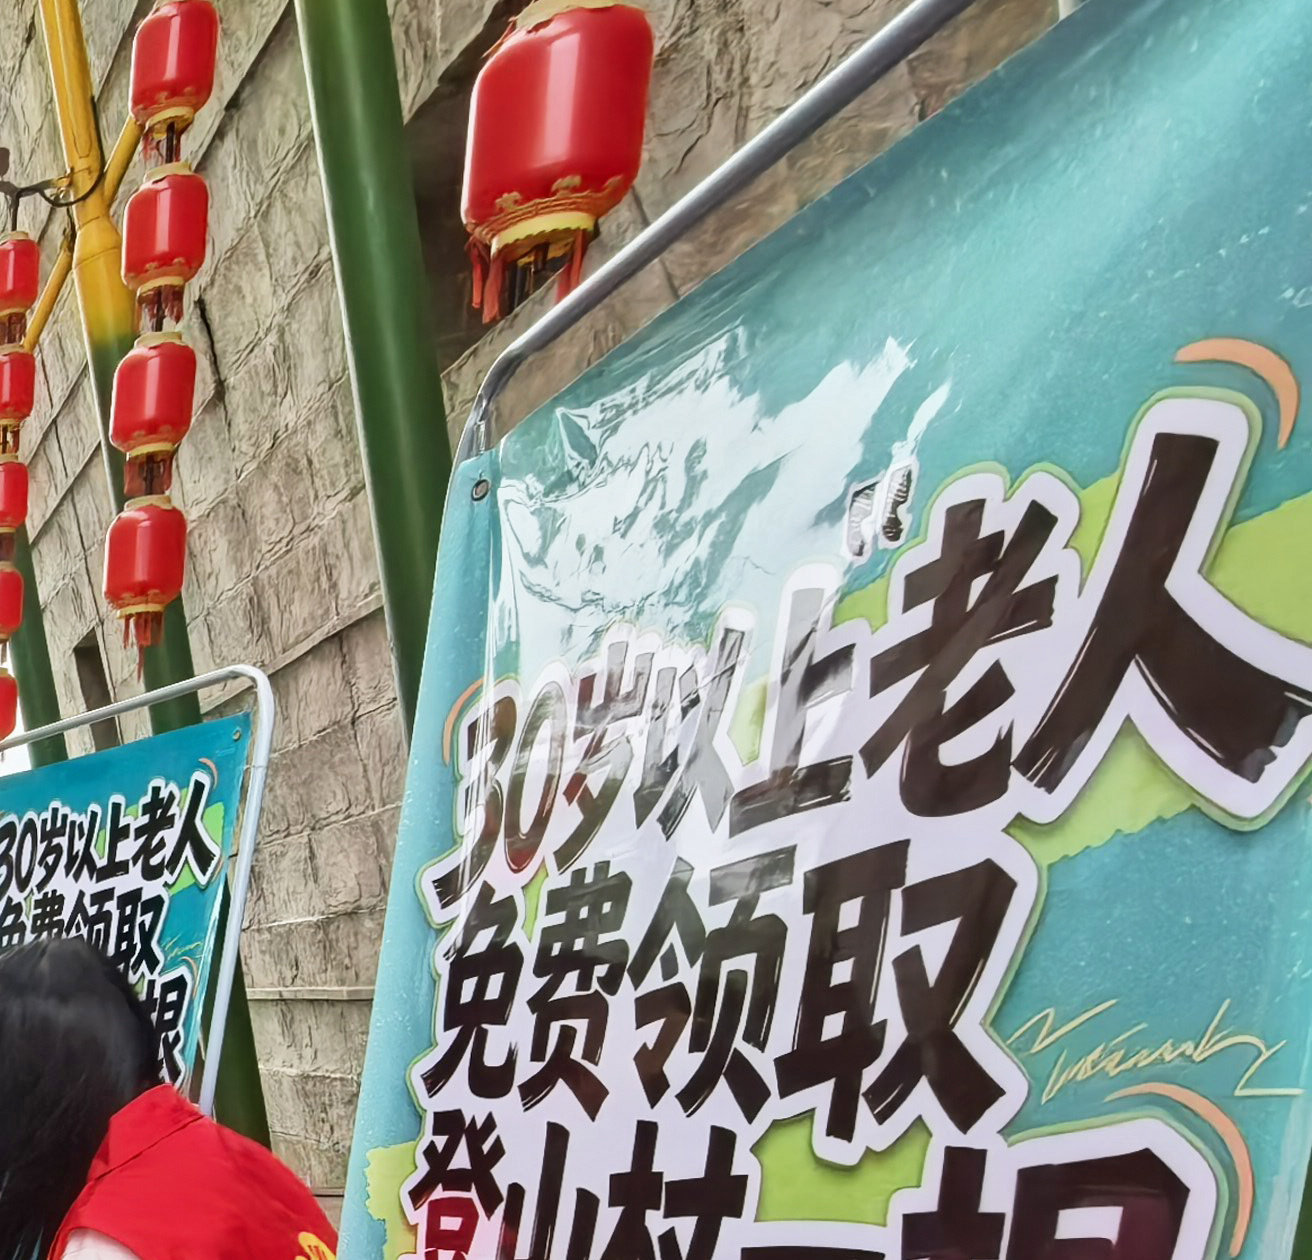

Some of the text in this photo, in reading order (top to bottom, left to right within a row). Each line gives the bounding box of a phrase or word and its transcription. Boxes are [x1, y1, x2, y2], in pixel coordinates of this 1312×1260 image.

[433, 432, 1312, 908] 30岁以上老人
[421, 840, 1016, 1142] 免费领取
